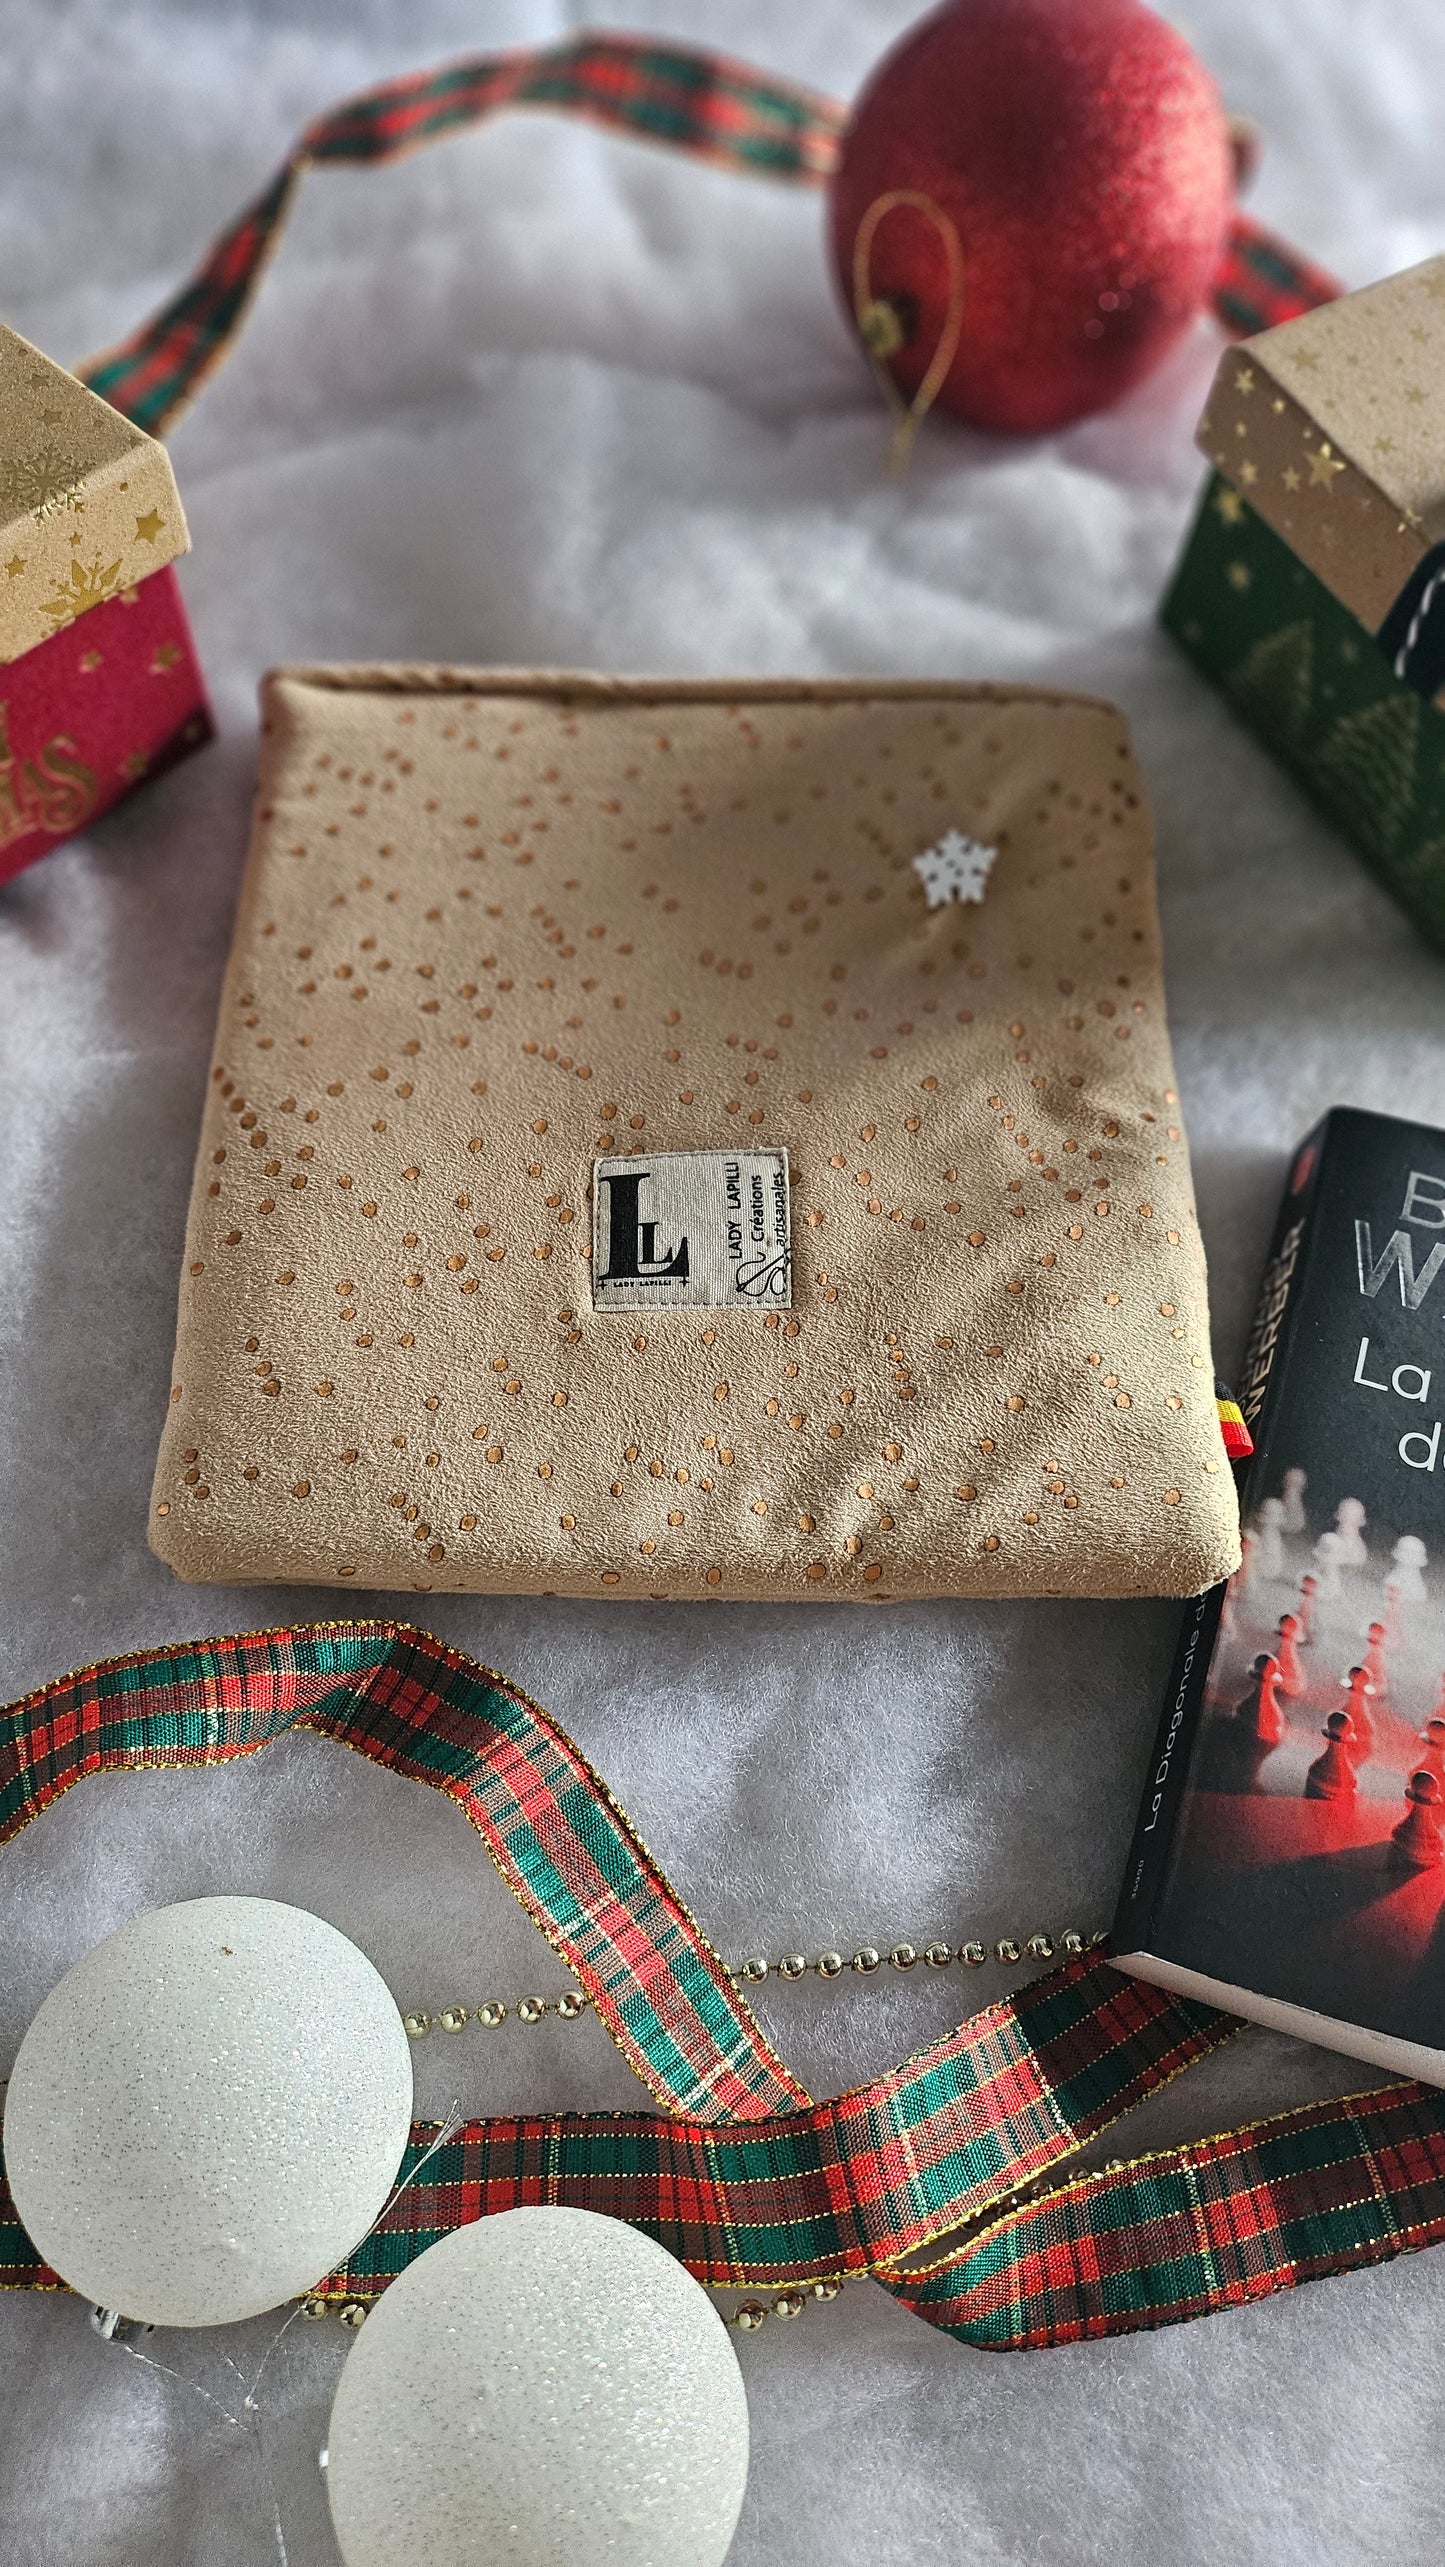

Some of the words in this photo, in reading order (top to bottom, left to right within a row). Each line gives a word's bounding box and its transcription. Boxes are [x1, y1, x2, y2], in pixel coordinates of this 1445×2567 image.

[724, 1162, 741, 1210] LAPILLI
[749, 1174, 765, 1242] Créations
[770, 1171, 787, 1248] artisanales
[728, 1220, 743, 1260] LADY
[639, 1279, 672, 1287] LAPILLI
[1353, 1336, 1432, 1403] La
[1144, 1792, 1163, 1832] La
[1155, 1629, 1200, 1783] Diagonale
